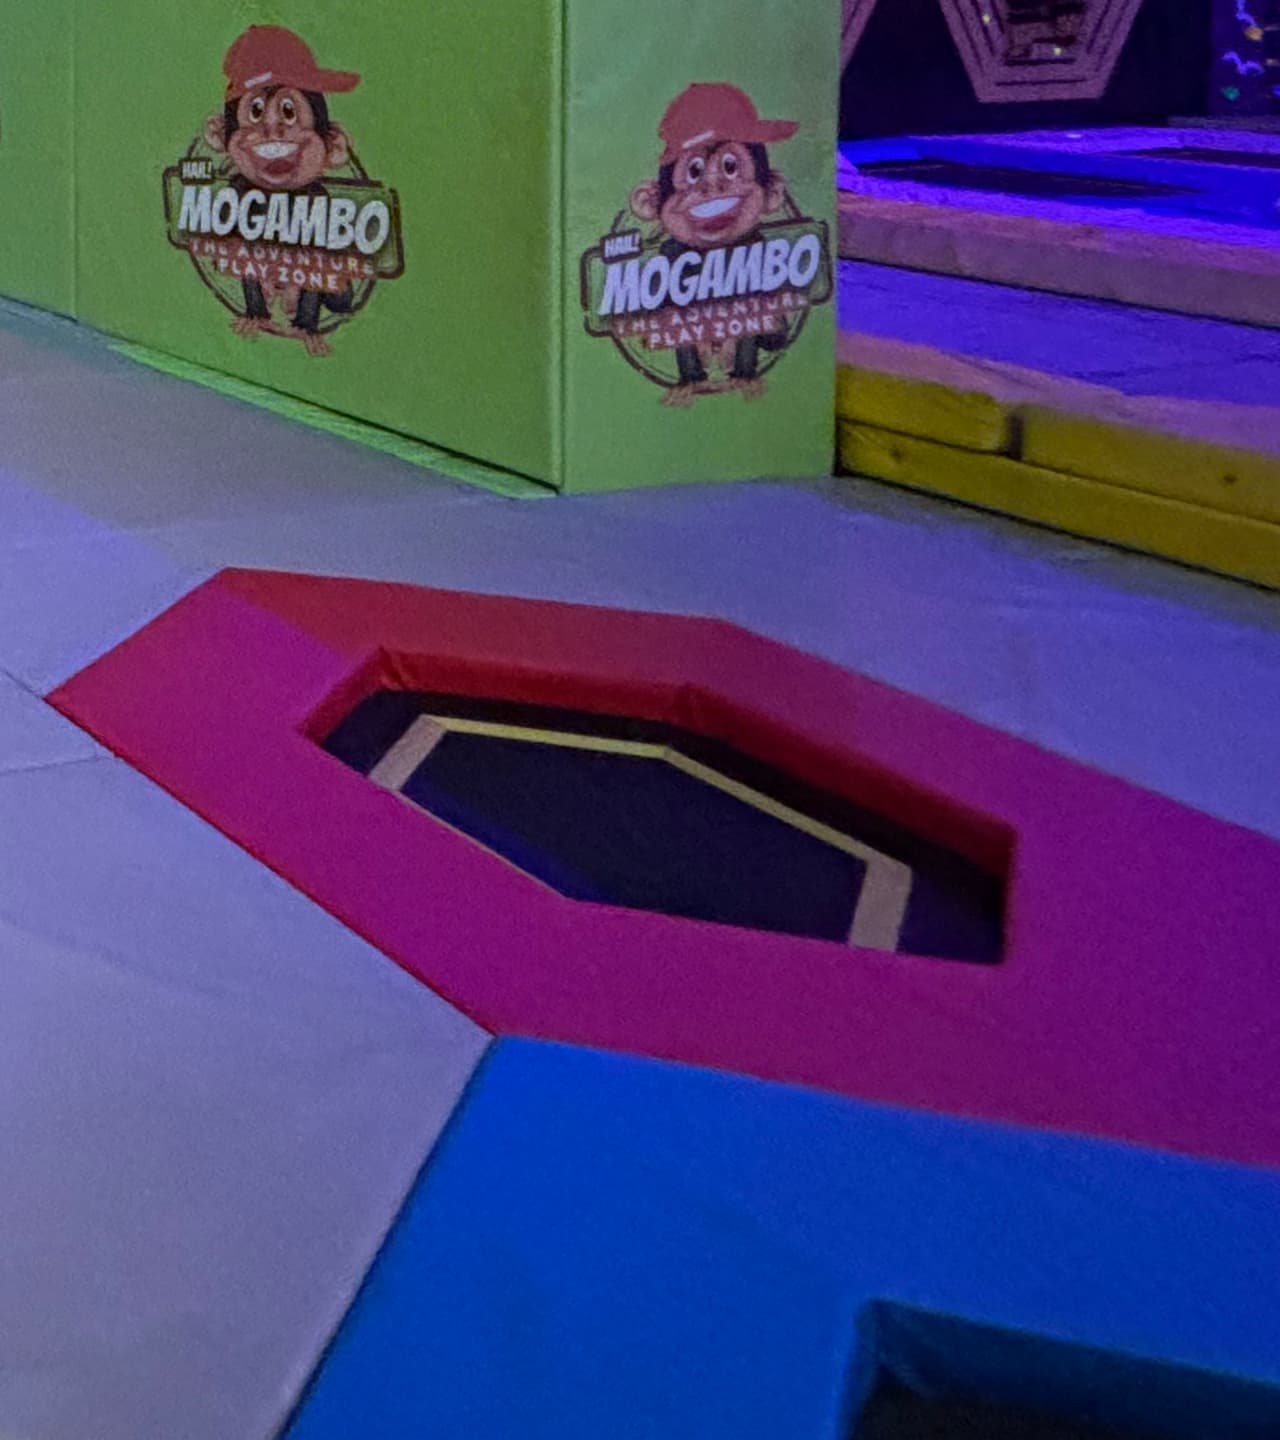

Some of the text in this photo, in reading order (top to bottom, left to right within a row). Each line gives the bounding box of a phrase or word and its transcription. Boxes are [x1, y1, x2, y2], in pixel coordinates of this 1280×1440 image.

[181, 160, 212, 179] HAIL!
[178, 186, 390, 254] MOGAMBO
[604, 233, 640, 258] HAIL!
[218, 258, 340, 290] PLAY ZONE
[599, 234, 821, 316] MOGAMBO
[649, 314, 775, 348] PLAY ZONE
